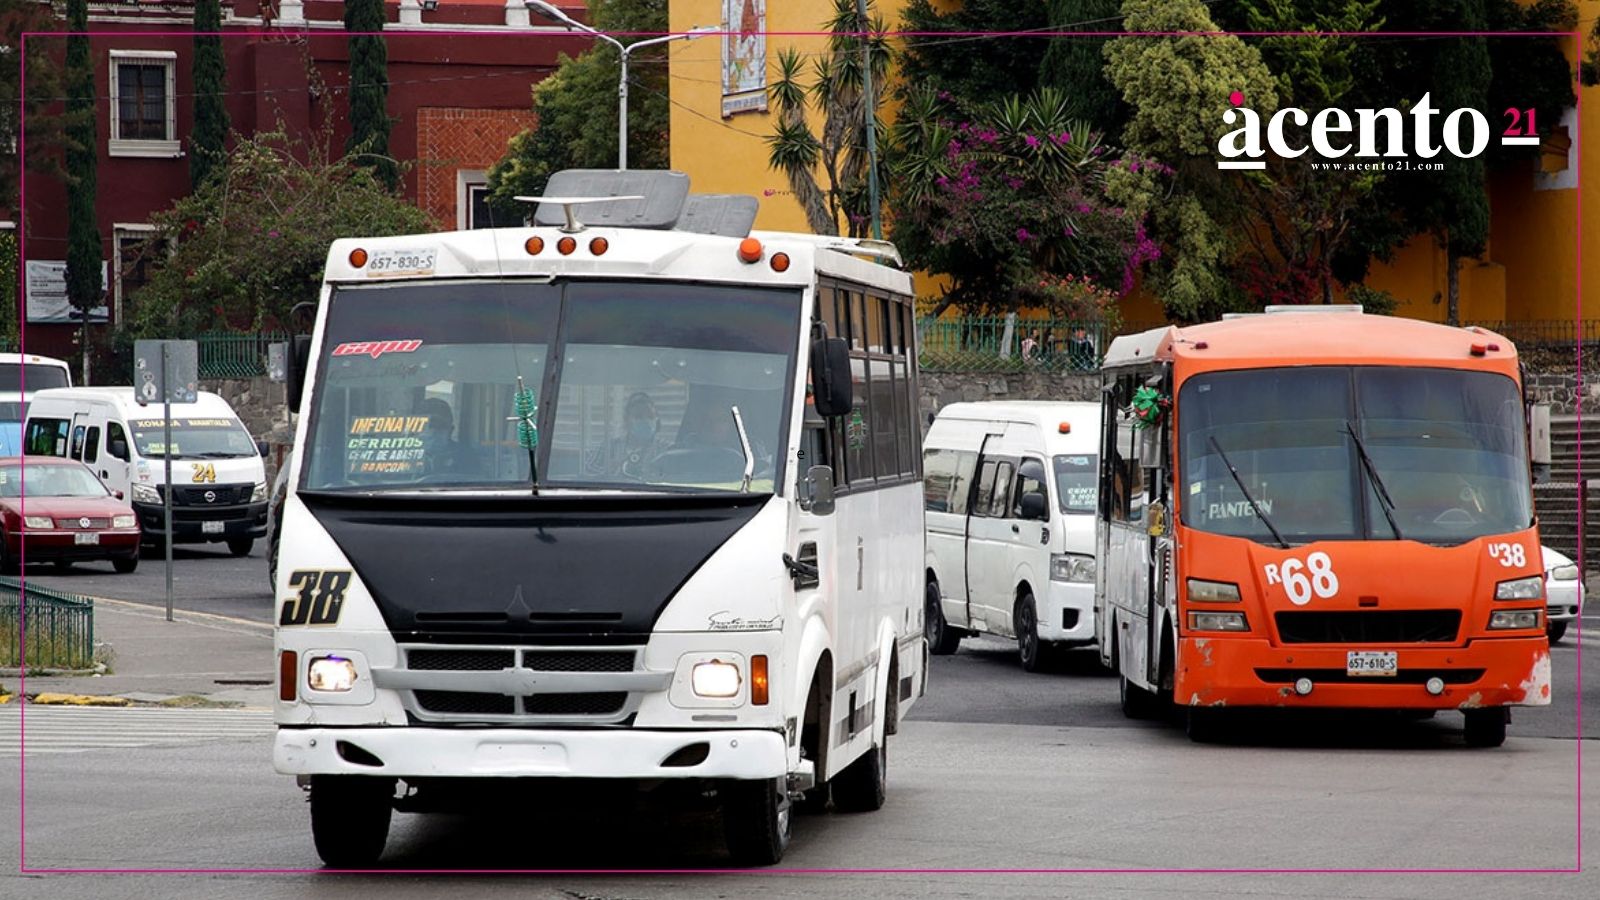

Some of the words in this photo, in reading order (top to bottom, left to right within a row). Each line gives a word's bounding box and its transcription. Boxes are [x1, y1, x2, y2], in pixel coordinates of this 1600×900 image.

[370, 254, 434, 270] 657-830-S
[350, 415, 429, 434] INFONAVIT
[348, 437, 424, 449] CERRITOS
[191, 463, 217, 483] 24
[279, 570, 353, 627] 38
[1348, 657, 1396, 670] 657-610-S
